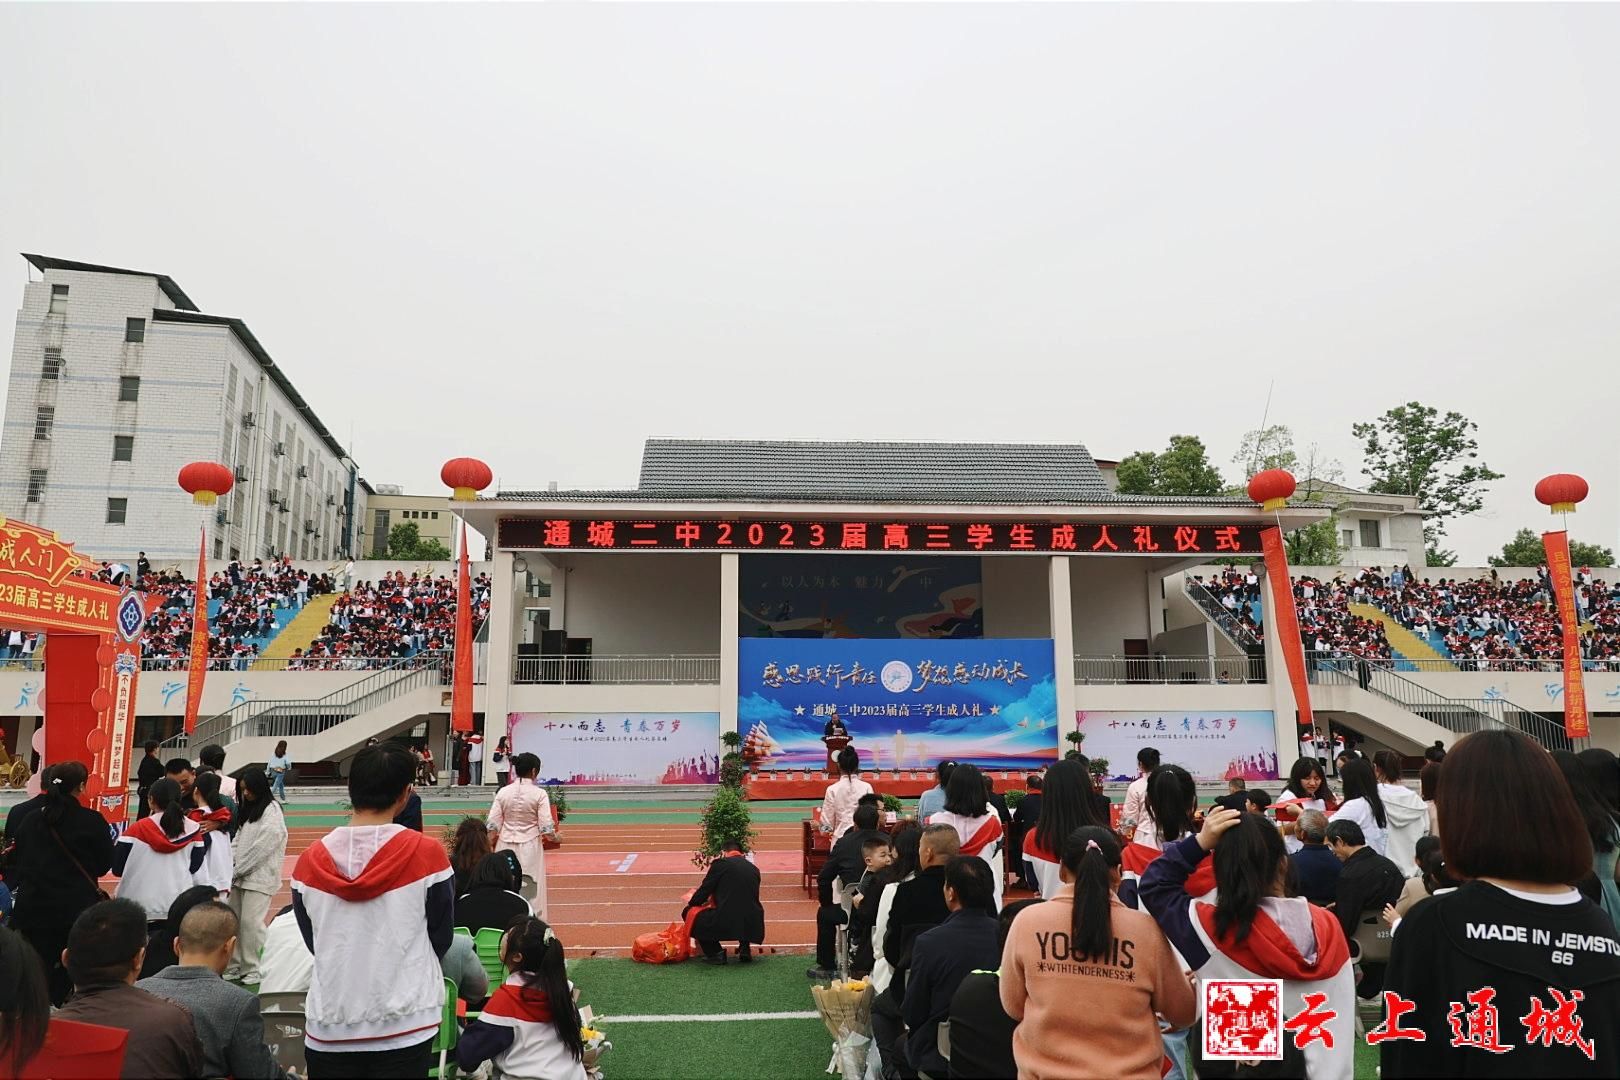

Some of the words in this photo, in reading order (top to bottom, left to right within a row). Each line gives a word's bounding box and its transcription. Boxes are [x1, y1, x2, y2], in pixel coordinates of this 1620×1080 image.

[543, 520, 1241, 552] 通城二中2023届高三学生成人礼仪式
[812, 703, 983, 717] 通城二中2023届高三学生成人礼
[544, 719, 606, 733] 十八而志
[620, 718, 681, 734] 青春万岁
[1466, 922, 1527, 943] MADE
[1532, 929, 1550, 946] IN
[1552, 951, 1574, 966] 66
